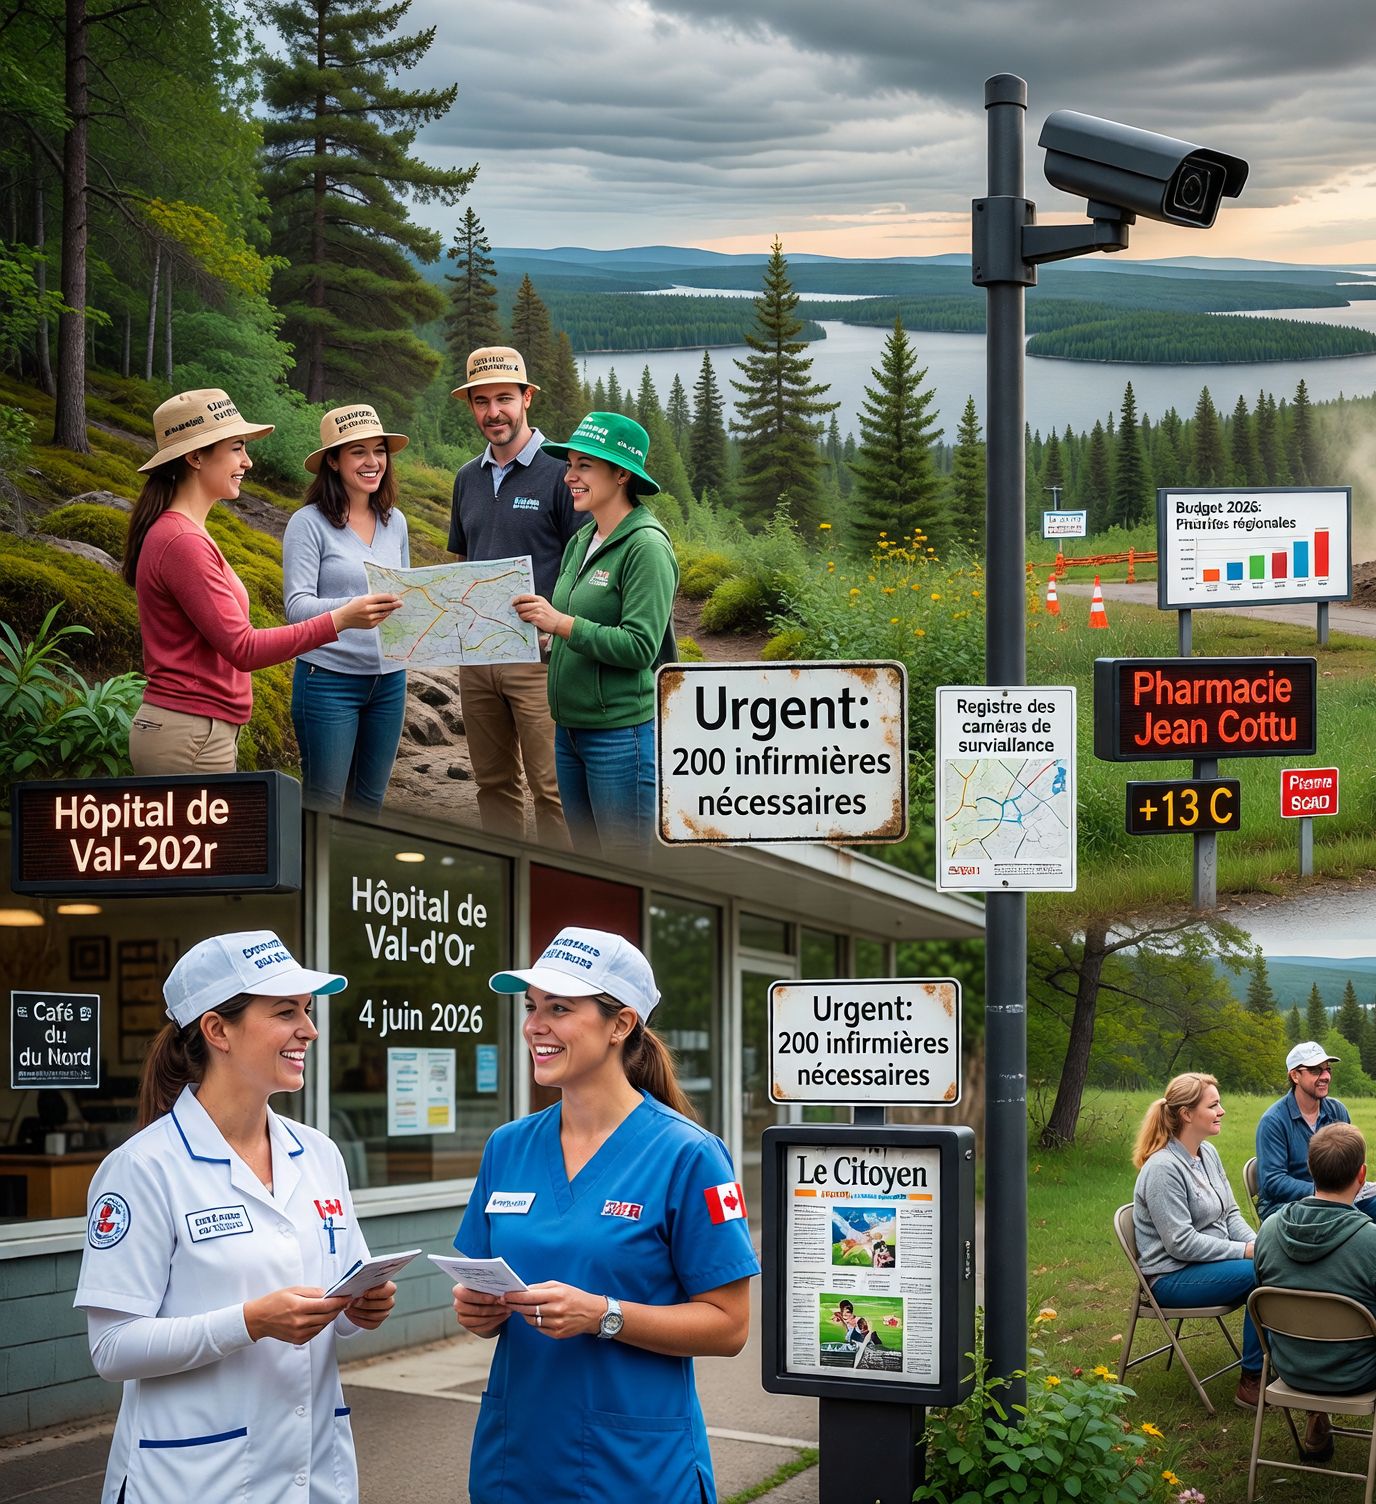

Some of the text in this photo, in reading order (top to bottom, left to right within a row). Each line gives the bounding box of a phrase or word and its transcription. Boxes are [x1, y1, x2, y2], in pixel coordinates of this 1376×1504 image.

[1227, 501, 1262, 514] 2026:
[1133, 670, 1292, 706] Pharmacie
[695, 685, 870, 742] Urgent:
[957, 698, 1056, 718] Registre des
[1032, 717, 1051, 733] de
[1134, 709, 1297, 746] Jean Cottu
[672, 745, 891, 776] 200 infirmières
[55, 789, 229, 837] Hôpital de
[698, 787, 867, 817] nécessaires
[1139, 787, 1233, 827] +13 C
[69, 835, 218, 873] Val-202r
[352, 876, 488, 929] Hôpital de
[365, 923, 475, 967] Val-d'Or
[33, 1001, 74, 1022] Café
[358, 1000, 483, 1037] 4 juin 2026
[812, 995, 913, 1028] Urgent:
[45, 1024, 67, 1043] du
[778, 1030, 949, 1055] 200 infirmières
[19, 1046, 91, 1066] du Nord
[797, 1062, 930, 1087] nécessaires
[797, 1155, 928, 1194] Le Citoyen
